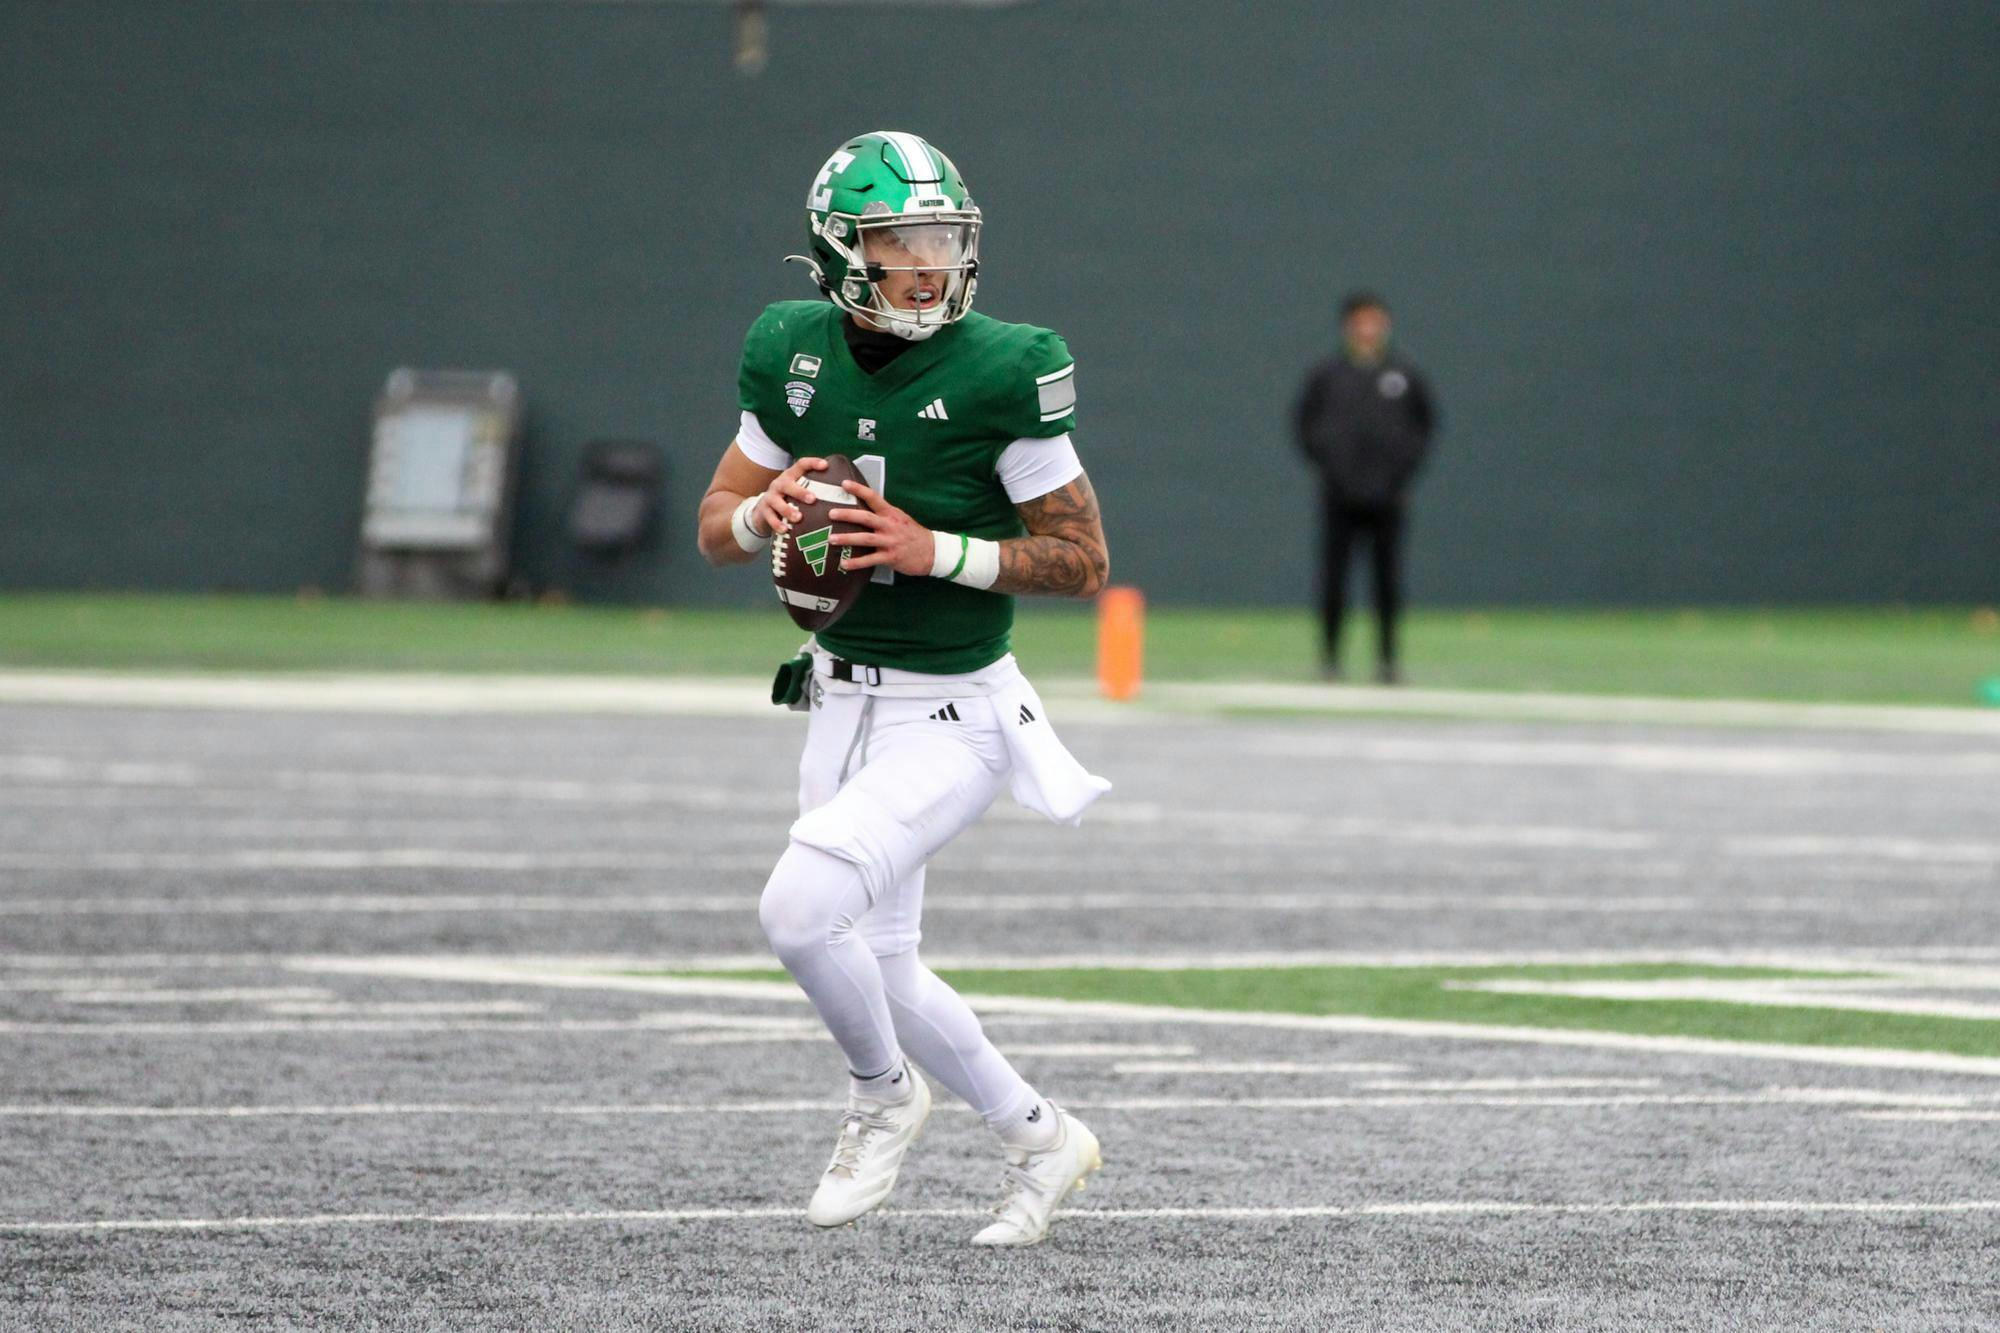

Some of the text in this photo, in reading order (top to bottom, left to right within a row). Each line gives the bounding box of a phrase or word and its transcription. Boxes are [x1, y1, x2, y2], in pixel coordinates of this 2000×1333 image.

[806, 150, 857, 213] E
[791, 354, 820, 377] C
[857, 418, 877, 441] E
